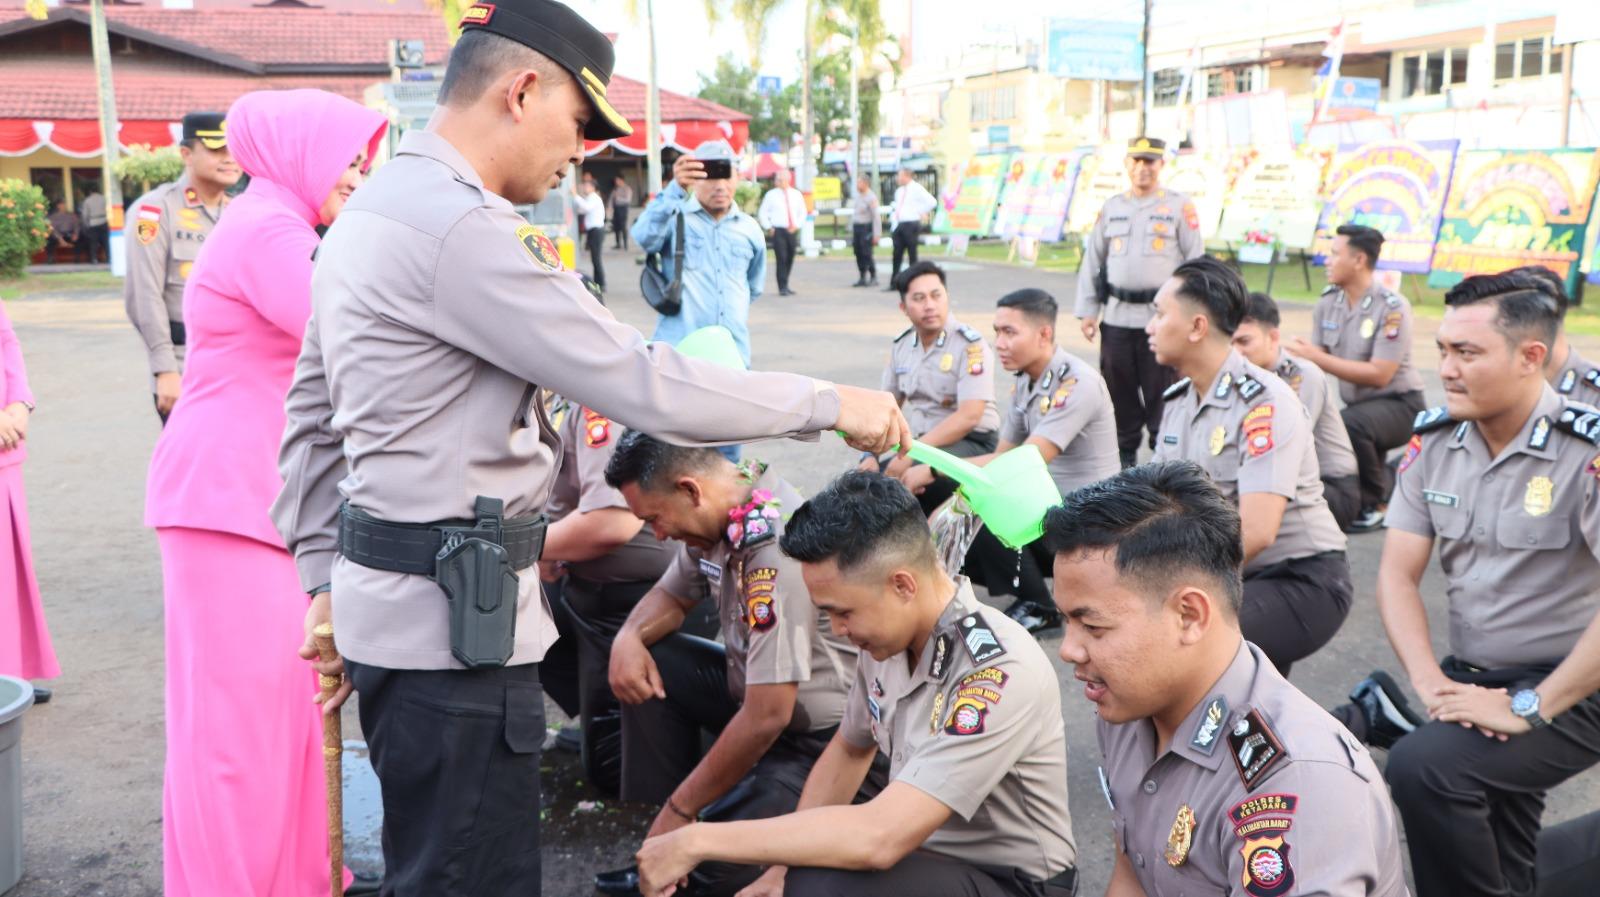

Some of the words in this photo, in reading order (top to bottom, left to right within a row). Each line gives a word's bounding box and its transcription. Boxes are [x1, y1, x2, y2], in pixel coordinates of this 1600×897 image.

[1240, 802, 1287, 818] KETAPANG
[1241, 796, 1281, 811] POLRES
[1238, 820, 1270, 836] KALIMANTAN
[1270, 819, 1289, 829] BARAT
